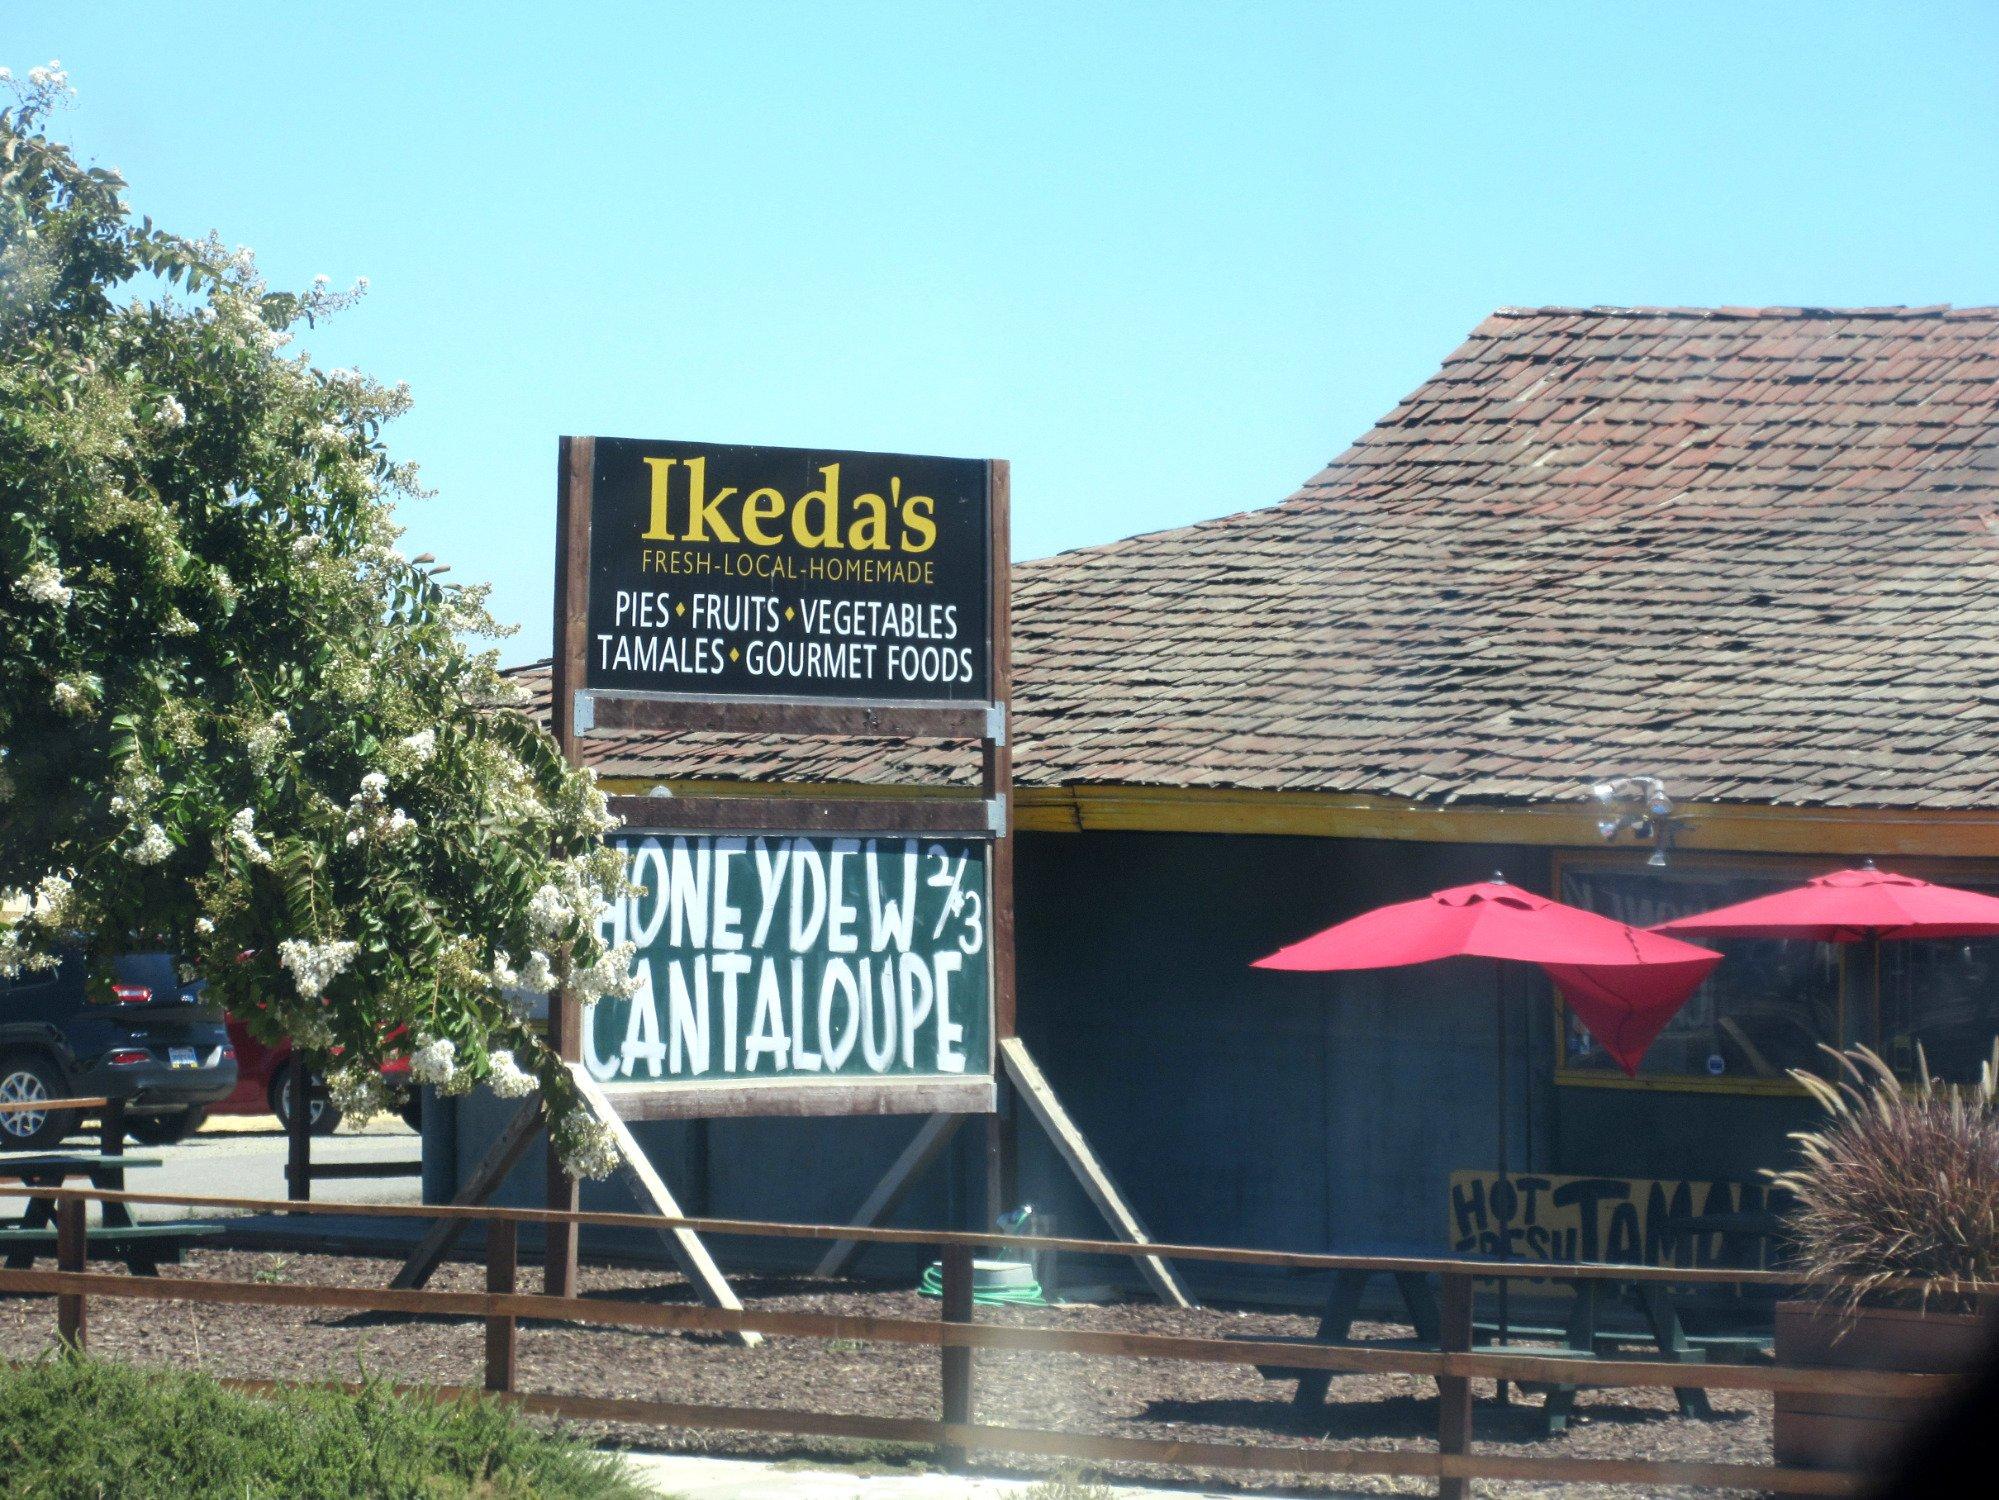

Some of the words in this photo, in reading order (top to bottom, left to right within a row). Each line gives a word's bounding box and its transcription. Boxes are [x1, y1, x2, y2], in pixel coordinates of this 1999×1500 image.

[641, 456, 938, 554] Ikeda's
[615, 591, 669, 628] PIES
[692, 594, 780, 633] FRUITS
[800, 599, 958, 640] VEGETABLES
[597, 634, 724, 675] TAMALES
[746, 639, 877, 680] GOURMET
[888, 645, 973, 683] FOODS
[597, 836, 918, 953] HONEYDEW
[583, 950, 966, 1080] CANTALOUPE
[1452, 1177, 1551, 1239] HOT
